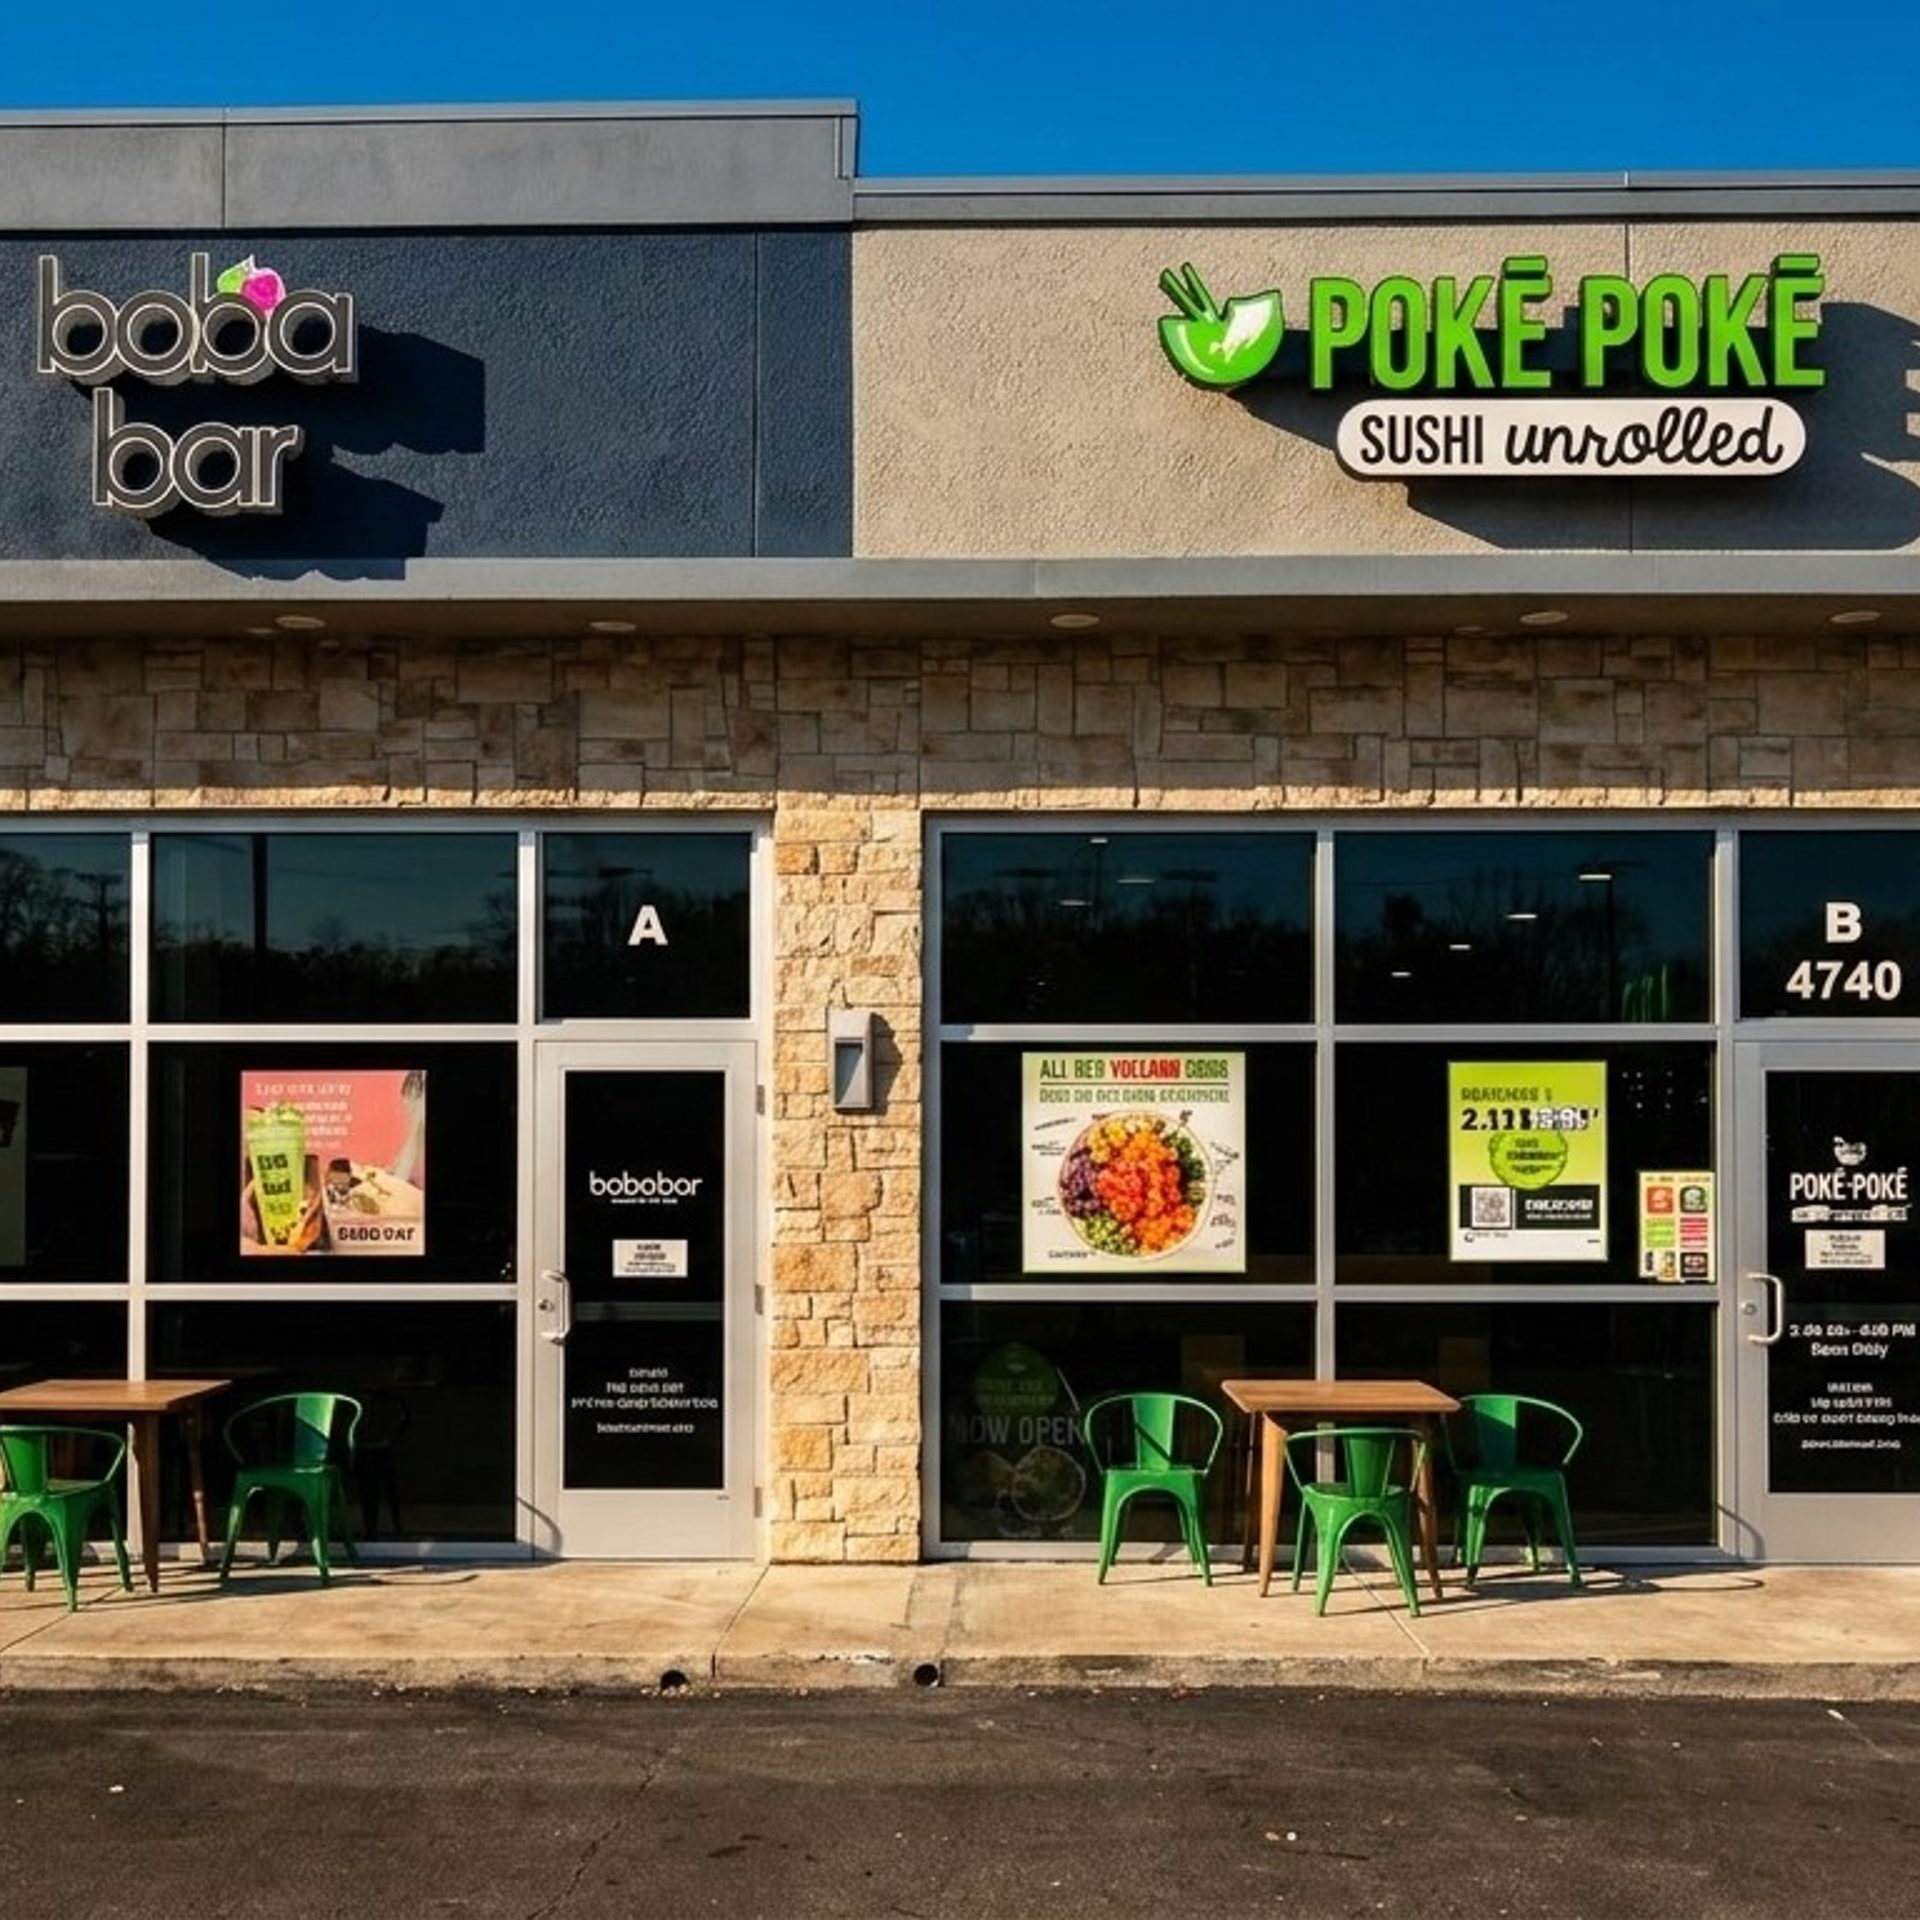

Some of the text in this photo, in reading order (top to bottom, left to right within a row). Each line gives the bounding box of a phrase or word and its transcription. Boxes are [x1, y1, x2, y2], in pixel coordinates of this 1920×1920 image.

[37, 251, 357, 384] boba
[92, 387, 304, 517] bar
[1360, 405, 1784, 467] SUSHI unrolled
[627, 904, 669, 946] A
[1825, 901, 1862, 943] B
[1786, 960, 1902, 1000] 4740
[950, 1415, 1011, 1445] NOW
